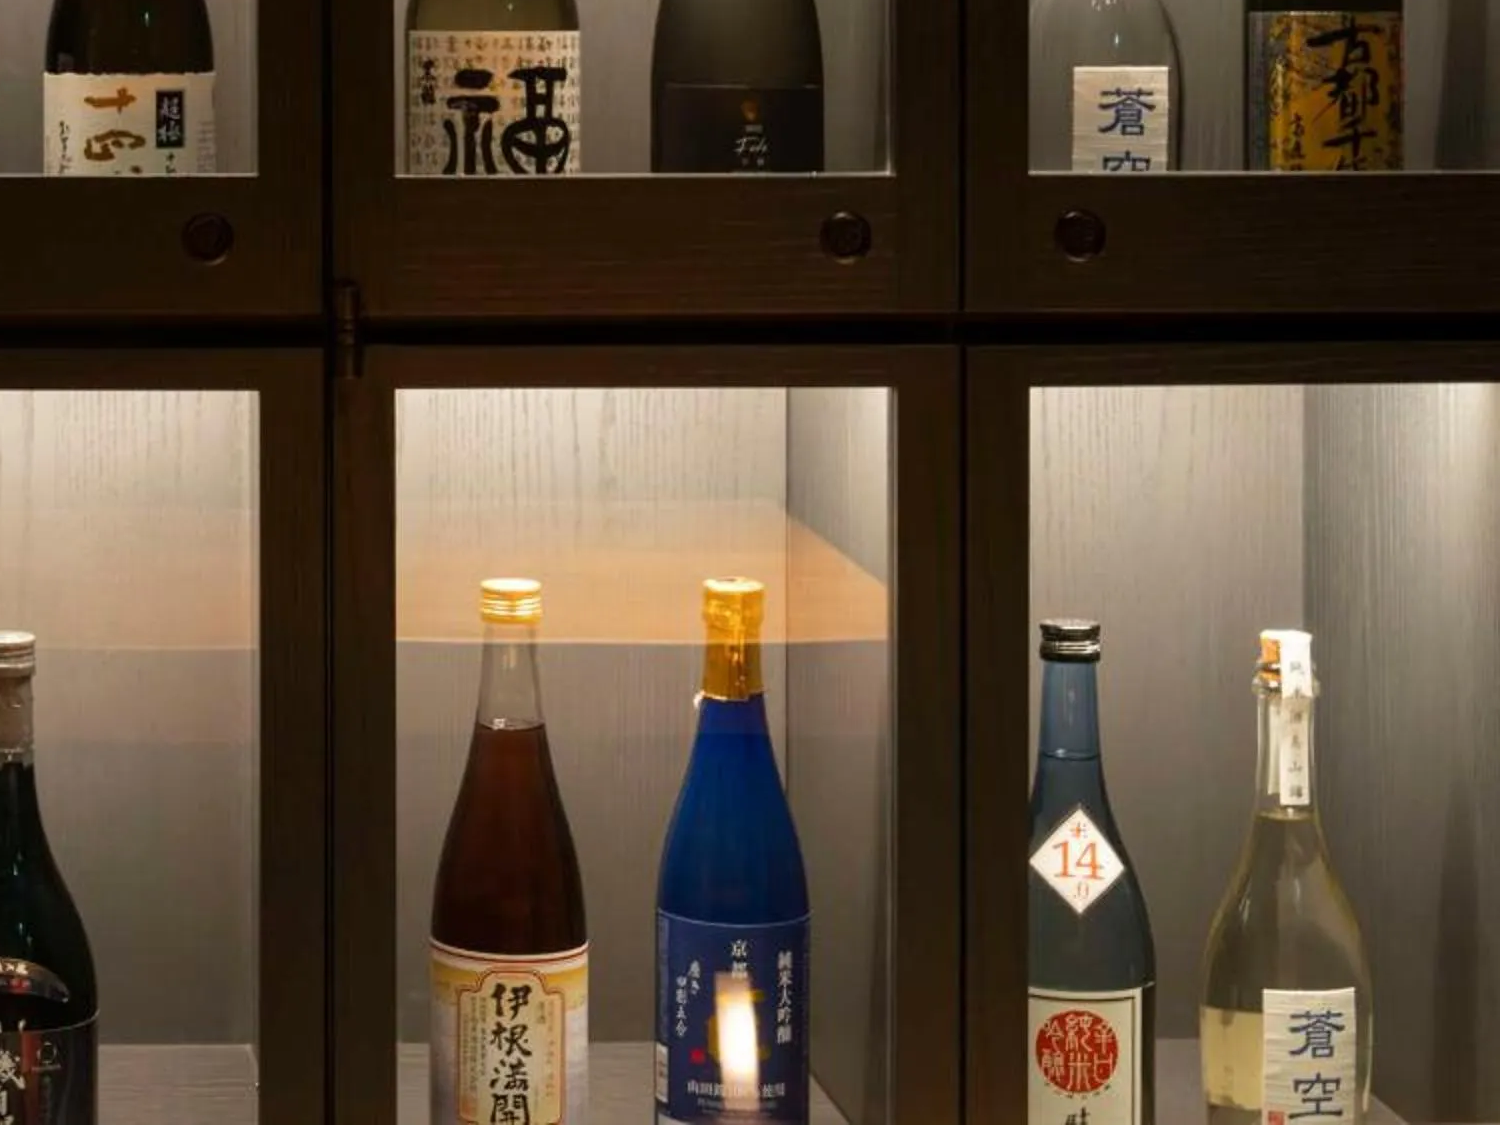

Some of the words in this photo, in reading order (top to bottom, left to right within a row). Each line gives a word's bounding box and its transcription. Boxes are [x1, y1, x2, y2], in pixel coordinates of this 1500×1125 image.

[84, 86, 146, 174] 十四
[1051, 840, 1106, 881] 14
[1287, 1008, 1346, 1120] 蒼空
